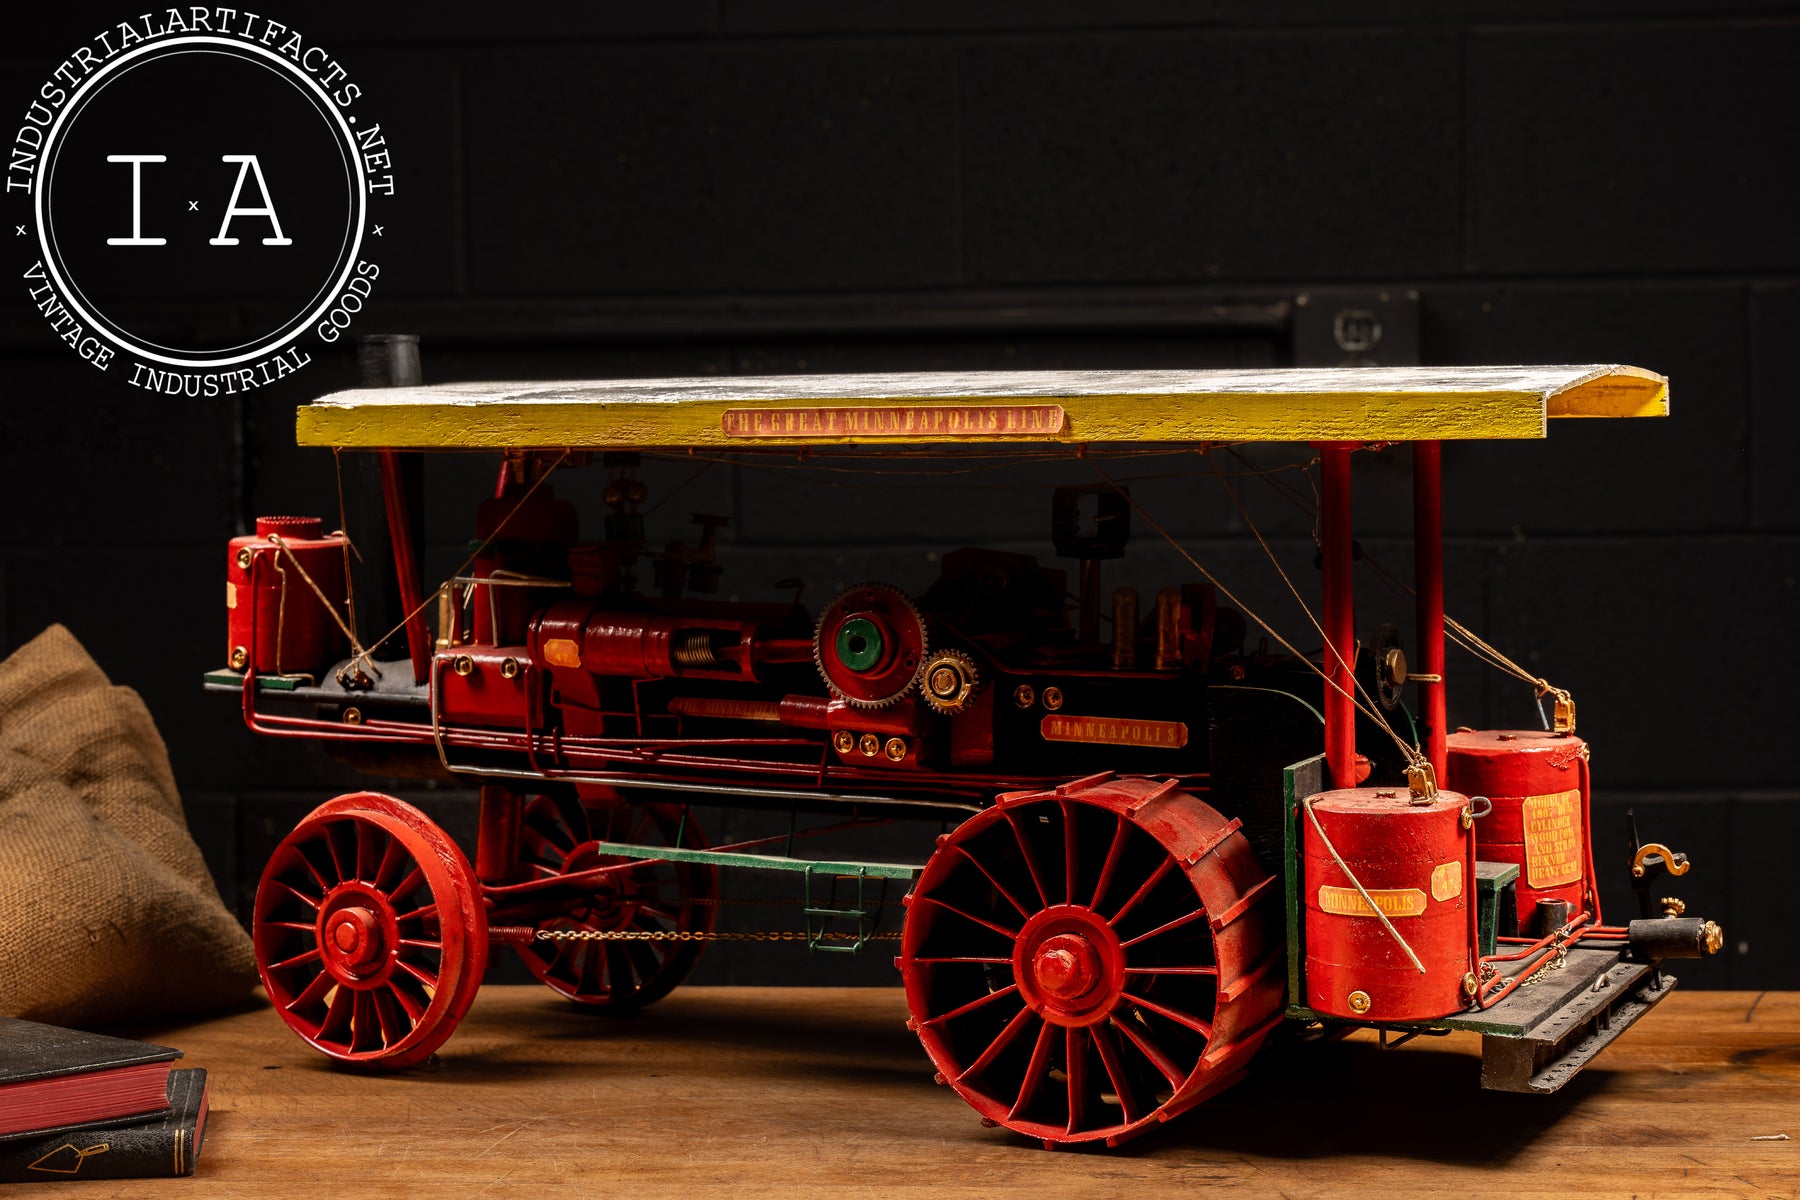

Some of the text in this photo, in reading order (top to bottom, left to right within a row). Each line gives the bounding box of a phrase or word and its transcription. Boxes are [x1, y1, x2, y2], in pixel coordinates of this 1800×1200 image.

[725, 409, 1057, 431] THE GREAT MINNEAPOLIS LINE
[1051, 720, 1175, 742] MINNEAPOLIS
[1532, 808, 1553, 819] 1907
[1530, 830, 1557, 844] WOOD
[1534, 843, 1551, 855] AND
[1532, 865, 1559, 879] HEAVY
